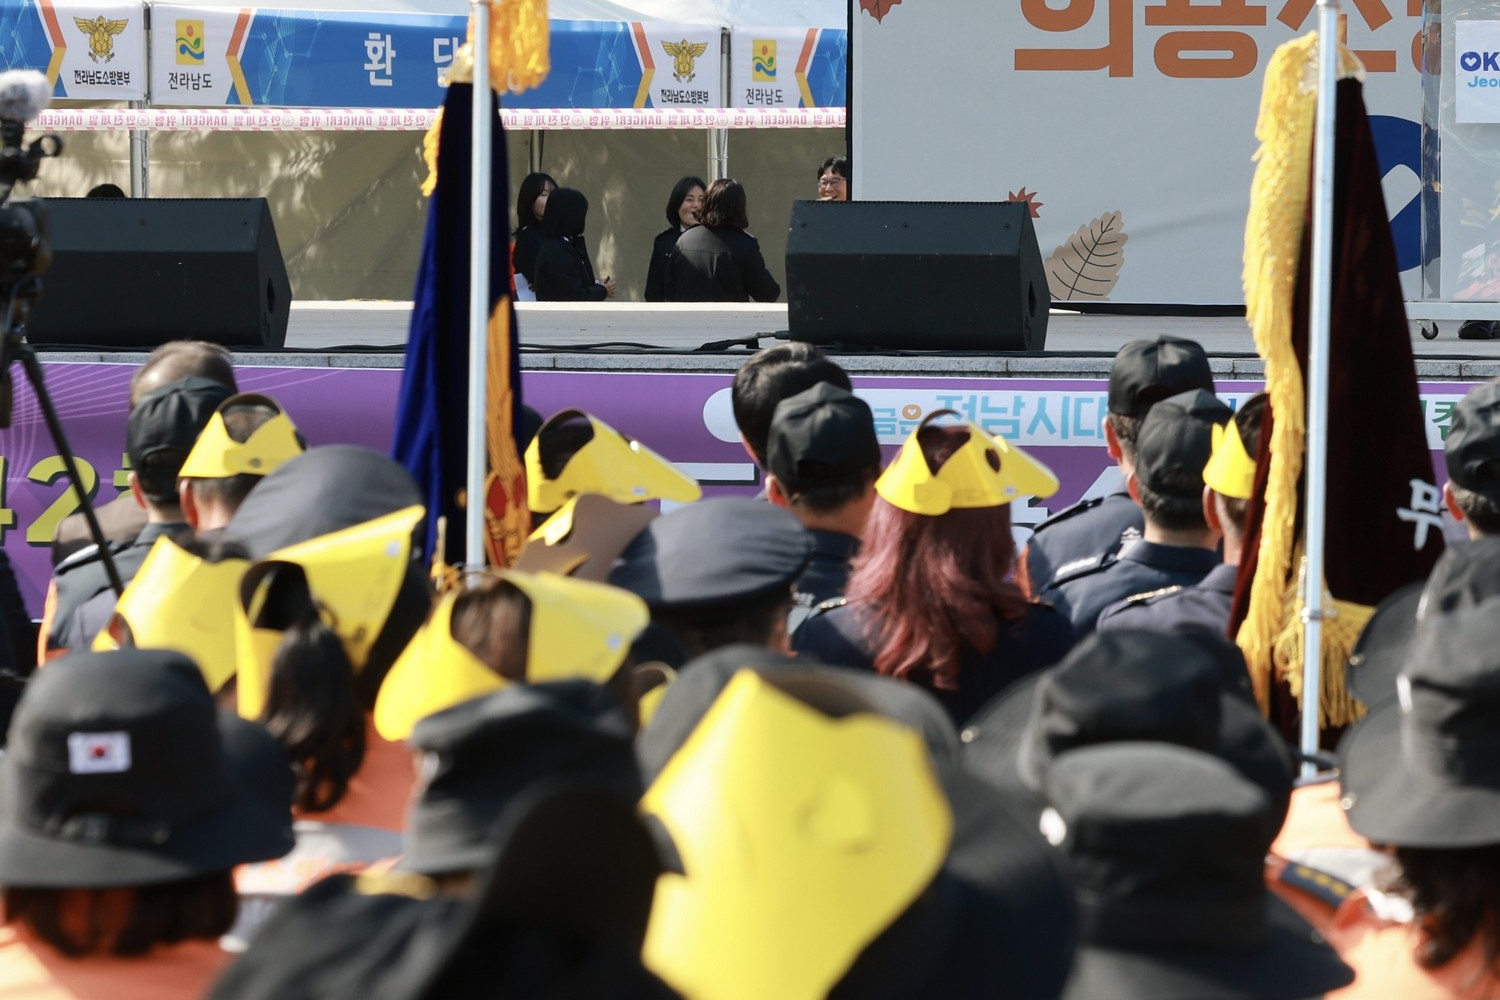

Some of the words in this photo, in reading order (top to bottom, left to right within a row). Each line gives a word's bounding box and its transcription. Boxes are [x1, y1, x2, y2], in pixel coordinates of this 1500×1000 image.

[364, 33, 396, 86] 환
[74, 70, 131, 85] 전라남도소방본부
[168, 72, 213, 90] 전라남도
[660, 89, 709, 104] 전라남도소방본부
[745, 88, 784, 105] 전라남도
